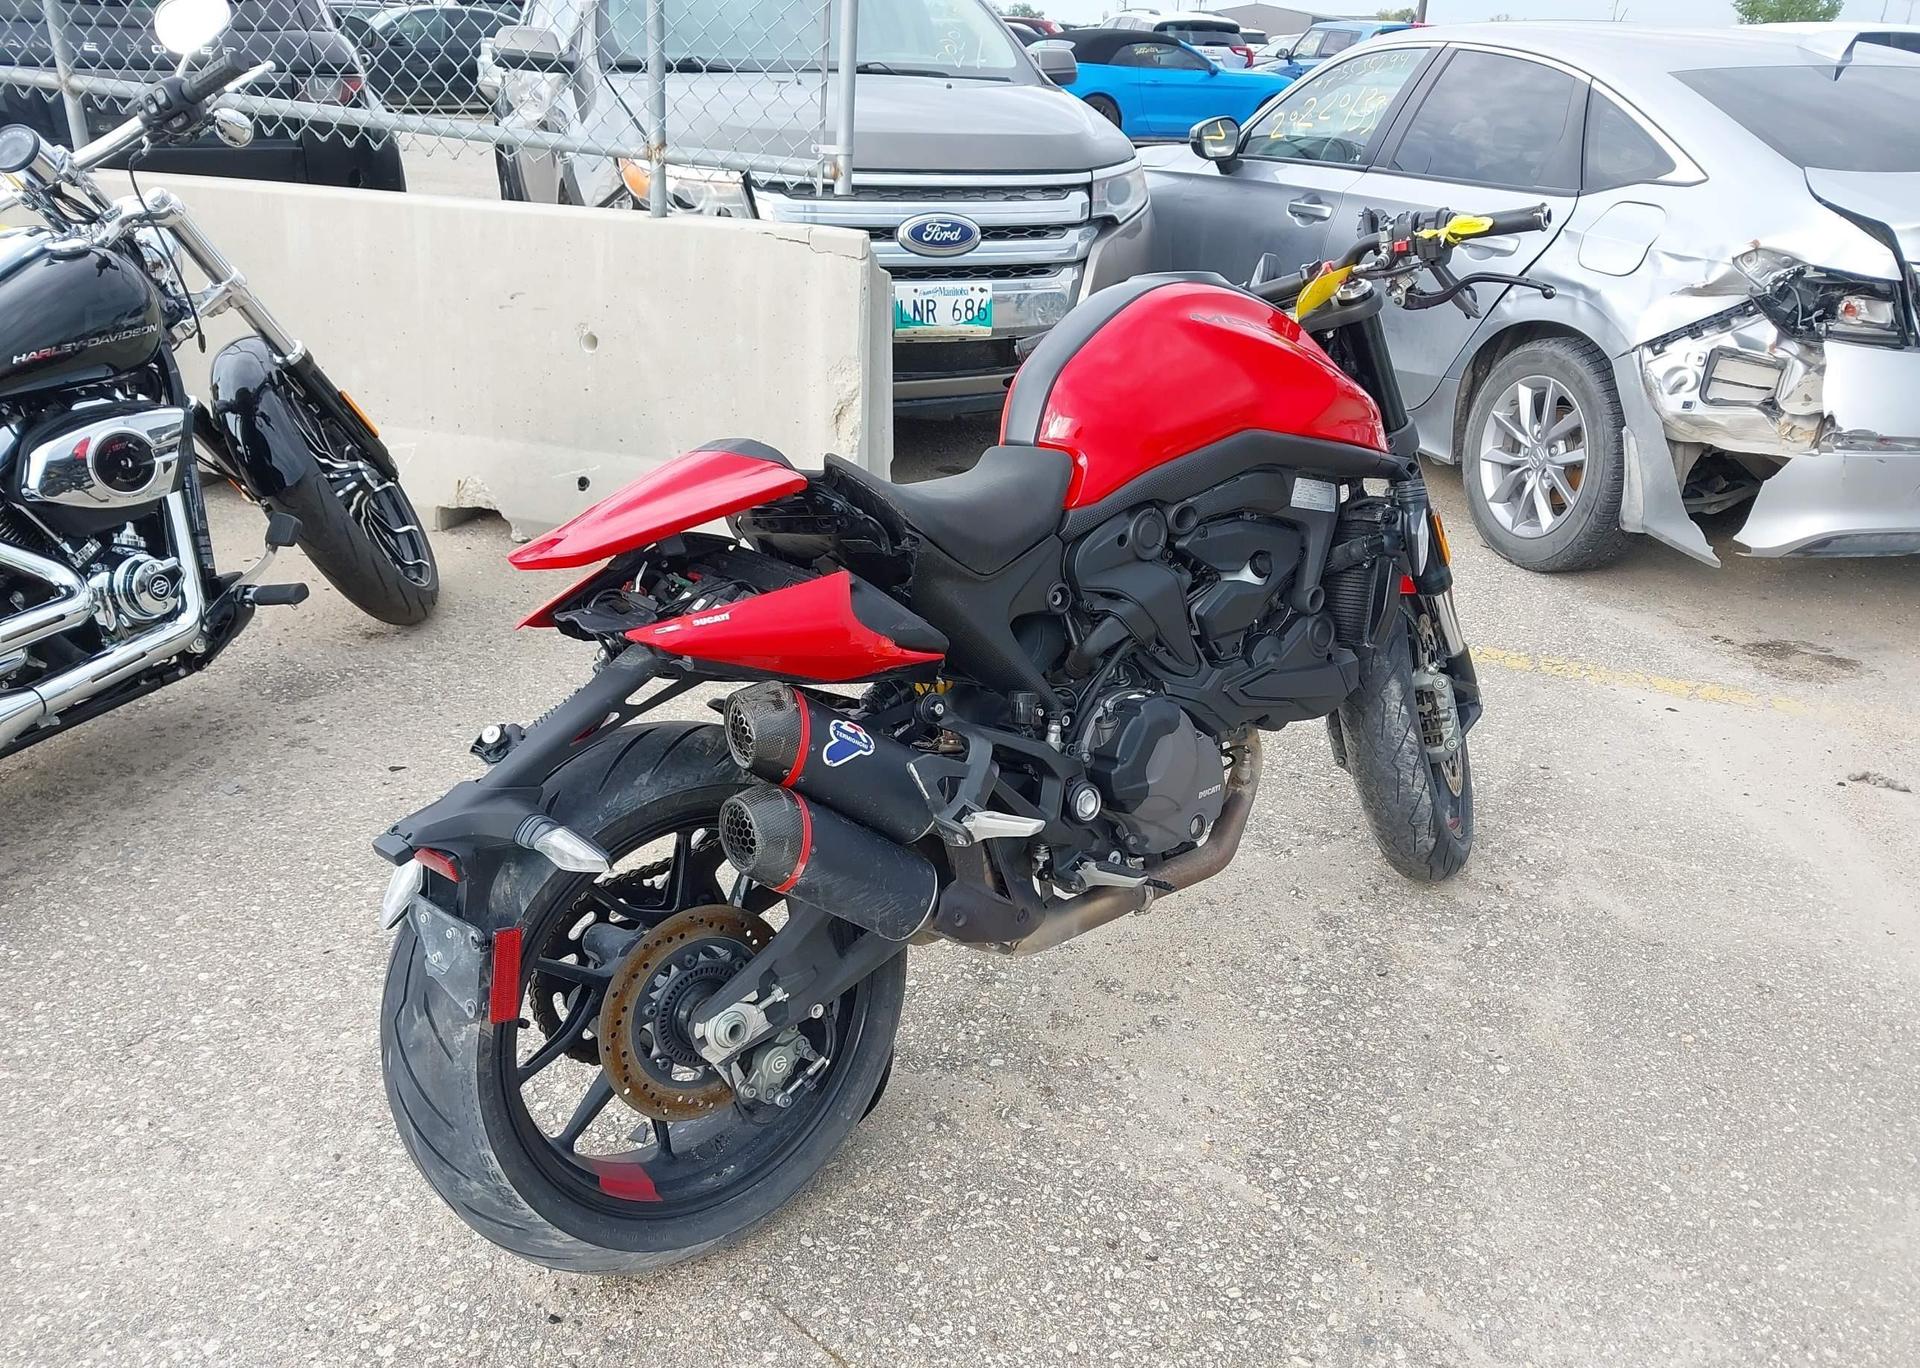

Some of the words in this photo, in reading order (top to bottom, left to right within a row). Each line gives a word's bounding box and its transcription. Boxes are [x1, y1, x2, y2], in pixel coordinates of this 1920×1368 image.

[126, 43, 237, 56] ROER
[922, 223, 962, 242] Ford
[900, 298, 937, 323] LNR
[951, 298, 988, 322] 686
[12, 323, 158, 364] HARLEY-DAVIDSON
[692, 613, 731, 627] DUCATI
[1198, 783, 1222, 800] DUCATI
